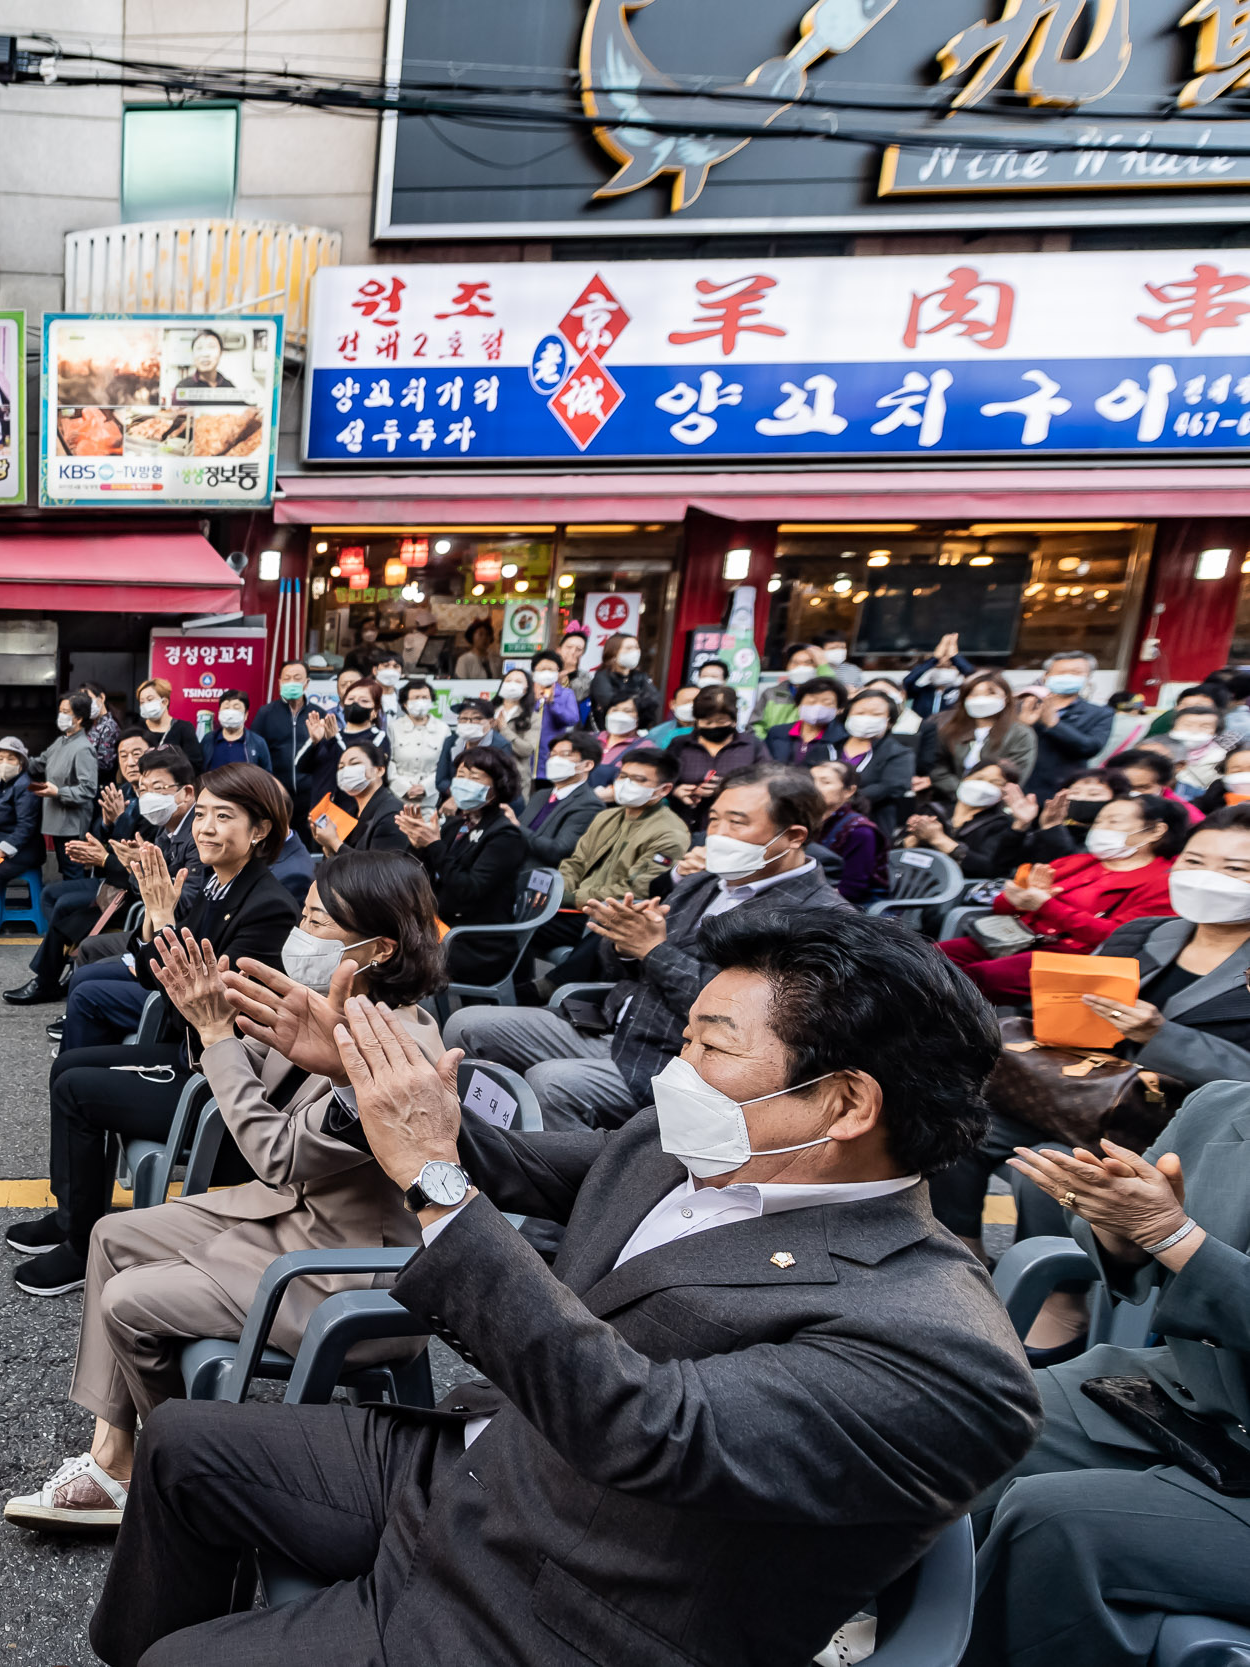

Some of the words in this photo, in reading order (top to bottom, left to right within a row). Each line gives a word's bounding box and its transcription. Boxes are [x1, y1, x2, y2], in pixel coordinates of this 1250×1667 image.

[352, 277, 496, 327] 원조
[330, 375, 500, 413] 양꼬치거리
[655, 363, 1178, 447] 양꼬치구이
[335, 416, 477, 453] 선두주자
[59, 465, 96, 480] KBS
[165, 646, 253, 665] 경성양꼬치
[182, 688, 229, 698] TSINGTA
[472, 1085, 511, 1127] 초대석
